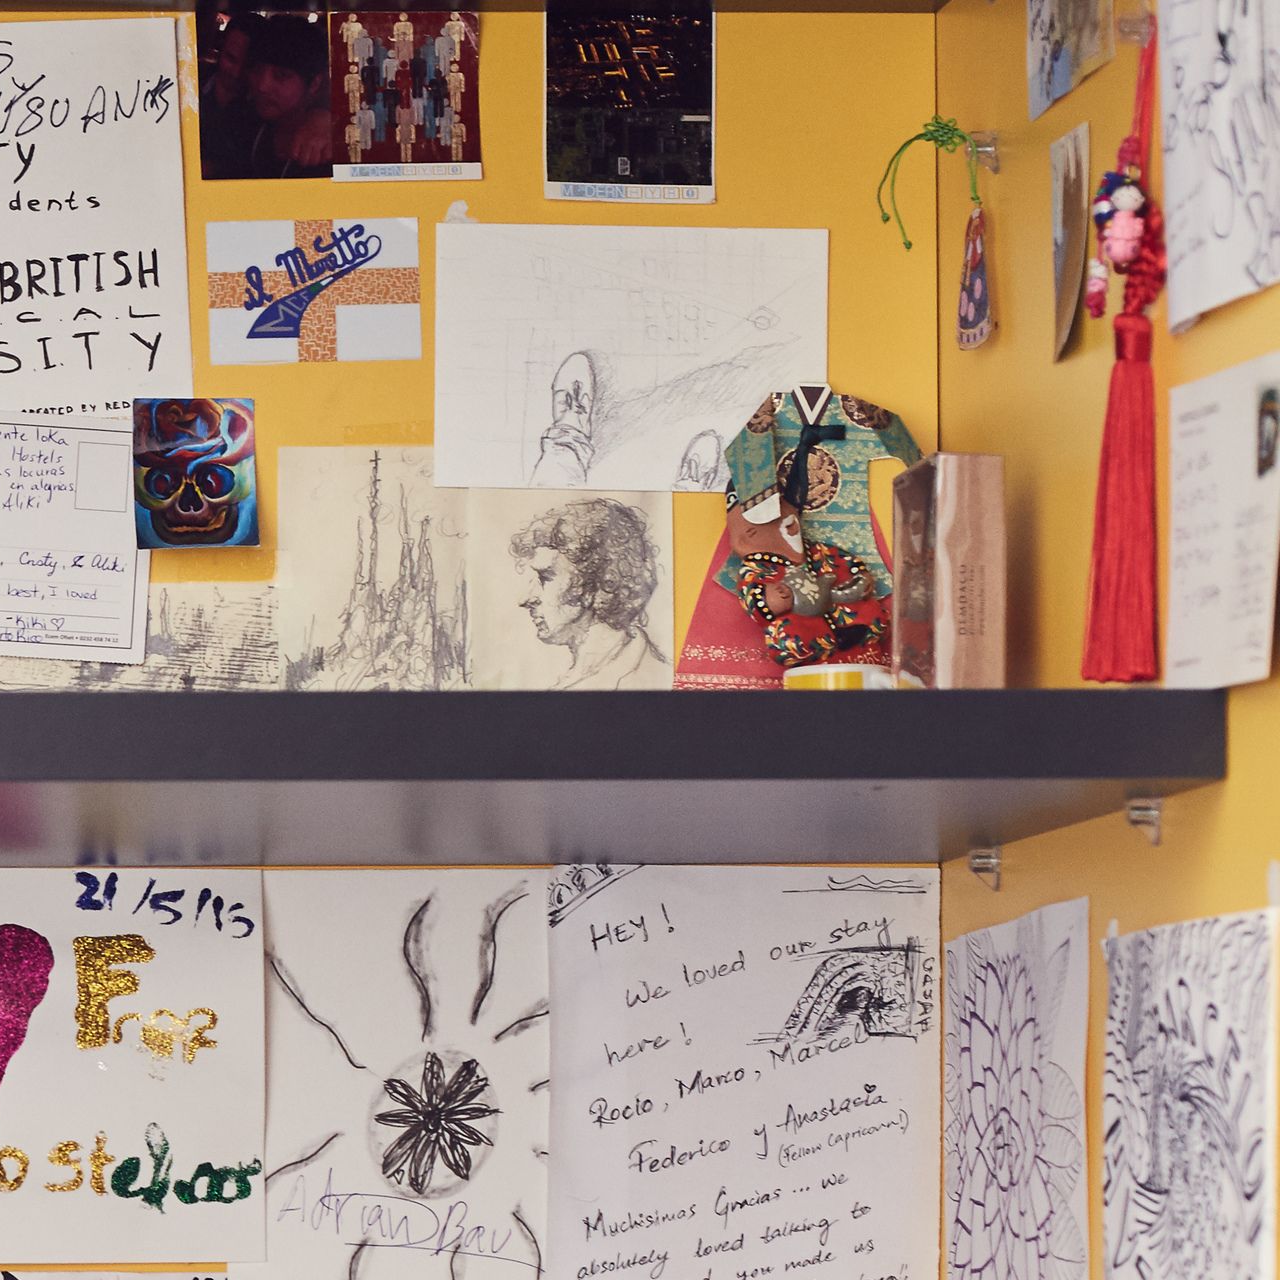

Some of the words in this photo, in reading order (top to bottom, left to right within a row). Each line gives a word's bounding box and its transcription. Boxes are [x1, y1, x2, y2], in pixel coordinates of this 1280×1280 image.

[683, 950, 747, 988] loved
[769, 940, 817, 962] our
[828, 917, 896, 950] stay
[628, 1138, 731, 1175] Federico
[695, 1233, 745, 1259] loved
[760, 1216, 838, 1246] talking
